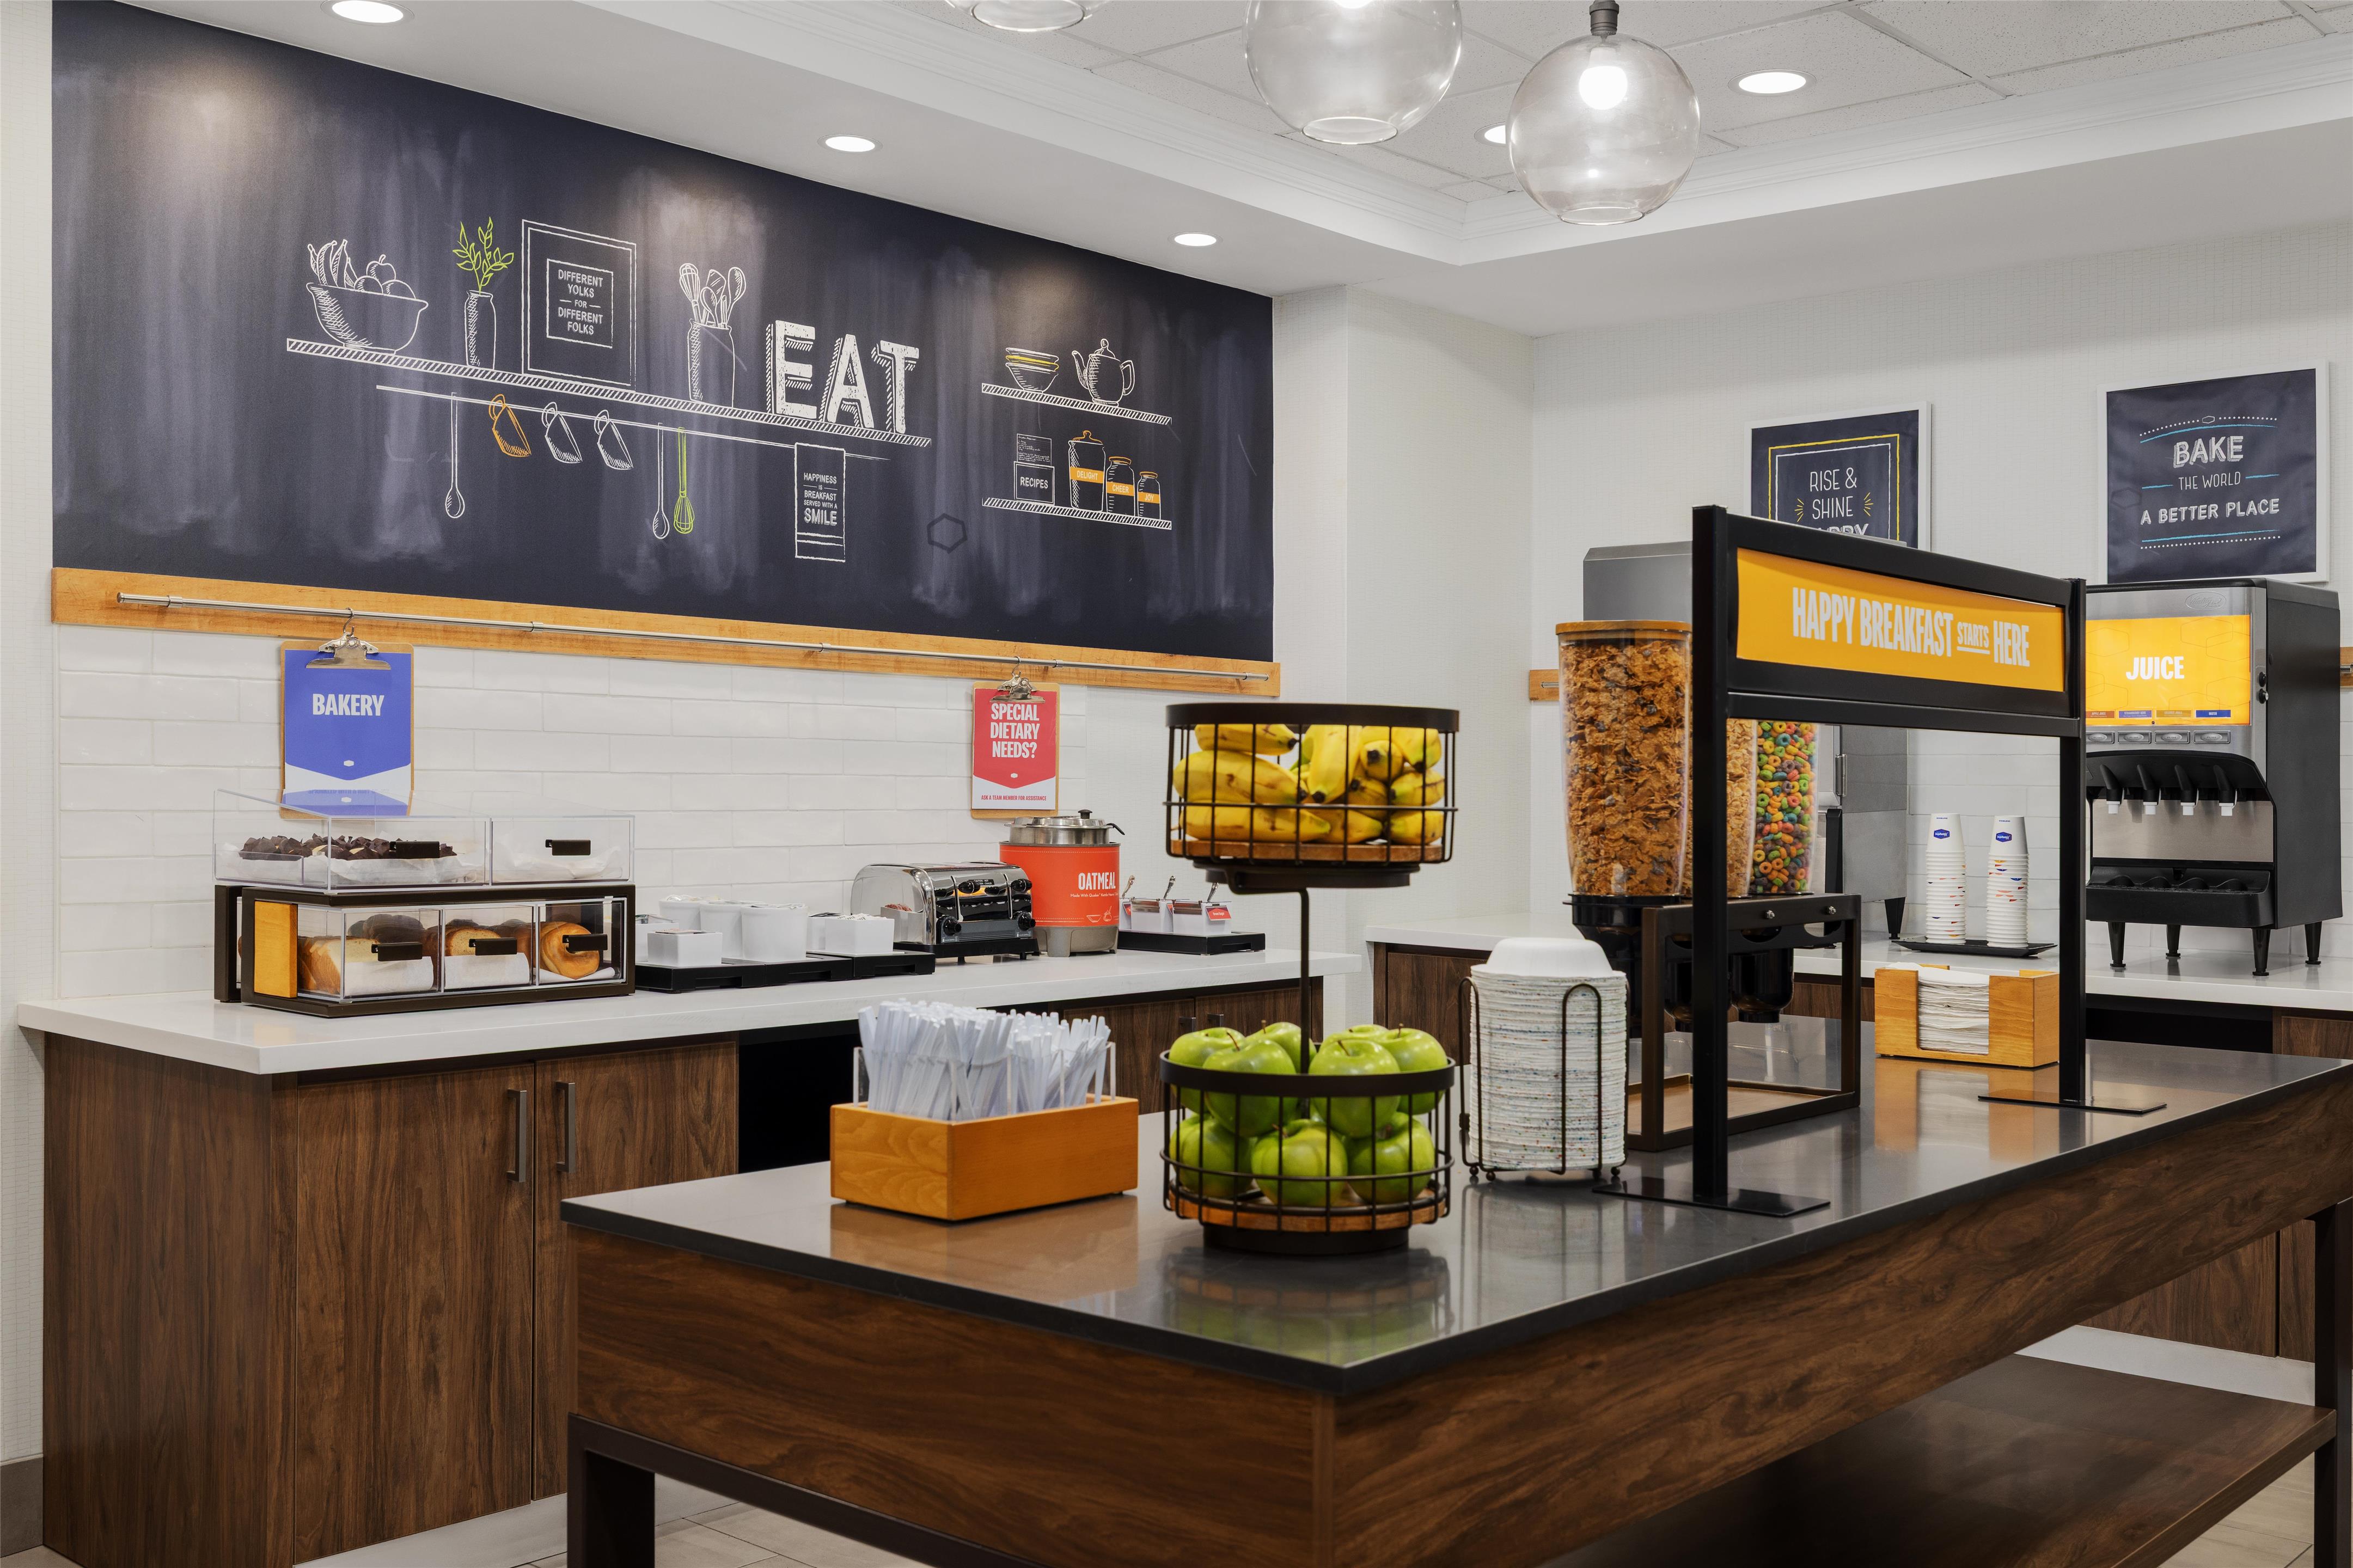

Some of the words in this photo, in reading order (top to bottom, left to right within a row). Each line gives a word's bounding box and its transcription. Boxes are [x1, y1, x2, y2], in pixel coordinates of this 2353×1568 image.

[558, 269, 603, 287] DIFFERENT
[567, 283, 595, 298] YOLKS
[575, 299, 587, 309] FOR
[558, 307, 603, 324] DIFFERENT
[567, 321, 594, 335] FOLKS
[766, 319, 920, 434] EAT
[2173, 436, 2244, 468] BAKE
[804, 472, 837, 485] HAPPINESS
[1019, 476, 1049, 490] RECIPES
[1077, 470, 1098, 481] DELIGHT
[1810, 469, 1840, 492] RISE
[1845, 467, 1857, 488] &
[2178, 475, 2198, 491] THE
[2202, 471, 2241, 488] WORLD
[804, 490, 837, 501] BREAKFAST
[1112, 484, 1129, 493] CHEER
[804, 507, 838, 526] SMILE
[1812, 496, 1854, 520] SHINE
[2140, 510, 2152, 525] A
[2158, 503, 2219, 524] BETTER
[2226, 498, 2280, 518] PLACE
[1792, 586, 1856, 645] HAPPY
[1860, 598, 1954, 657] BREAKFAST
[1957, 621, 1990, 648] STARTS
[1993, 620, 2031, 667] HERE
[2125, 656, 2185, 680] JUICE
[313, 693, 384, 716] BAKERY
[991, 703, 1040, 721] SPECIAL
[990, 722, 1040, 740] DIETARY
[992, 741, 1037, 758] NEEDS?
[1078, 872, 1116, 890] OATMEAL
